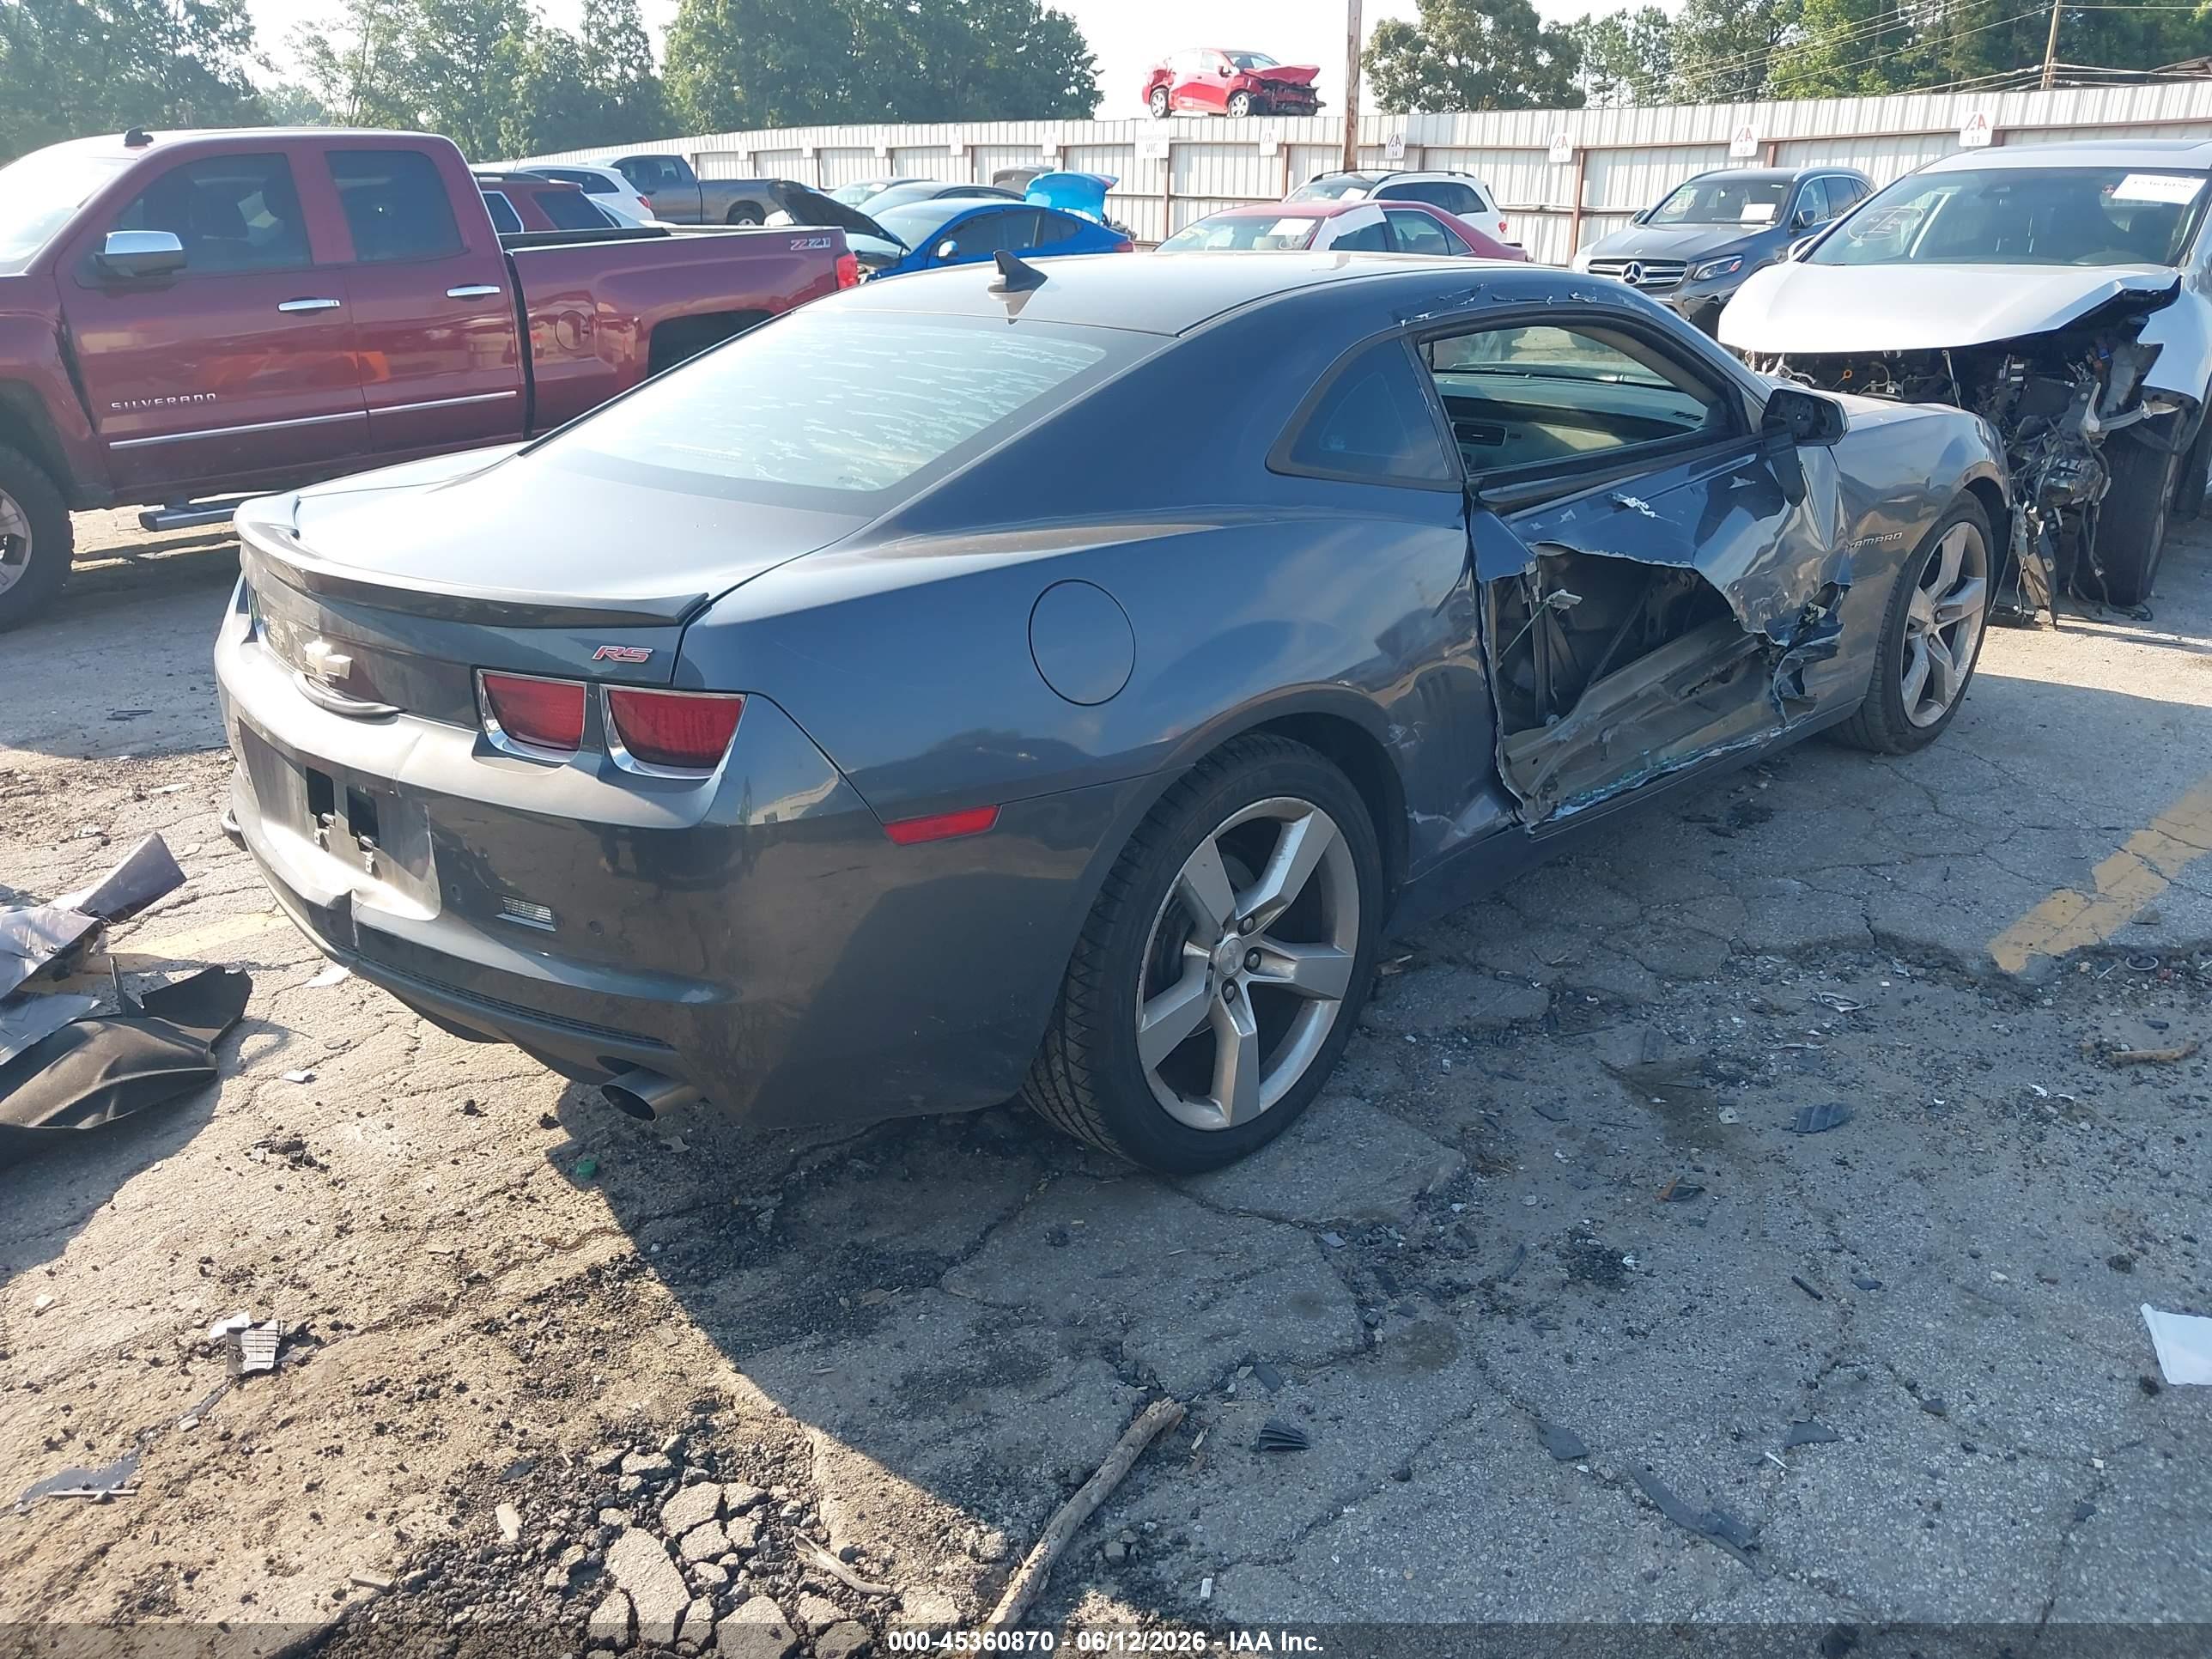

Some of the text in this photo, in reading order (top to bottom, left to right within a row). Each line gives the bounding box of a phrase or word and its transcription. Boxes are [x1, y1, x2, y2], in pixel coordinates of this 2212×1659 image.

[1146, 143, 1158, 154] VIC
[1971, 136, 1980, 144] 11
[110, 392, 217, 410] SILVERADO
[1849, 532, 1904, 550] CAMARO
[591, 645, 653, 664] RS
